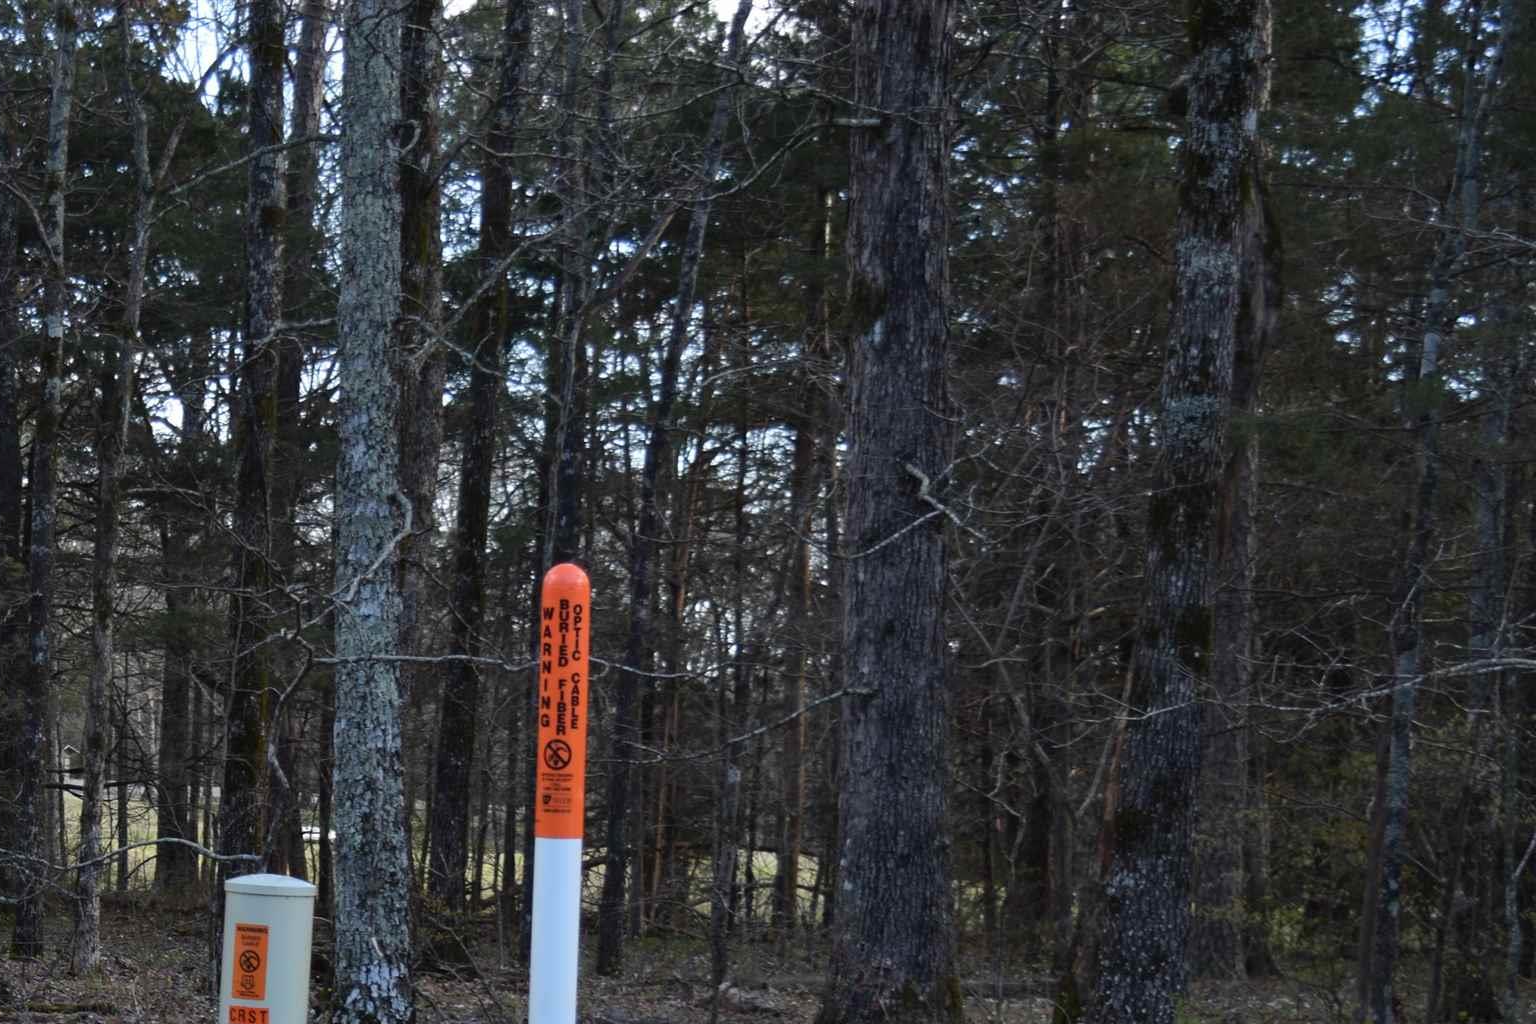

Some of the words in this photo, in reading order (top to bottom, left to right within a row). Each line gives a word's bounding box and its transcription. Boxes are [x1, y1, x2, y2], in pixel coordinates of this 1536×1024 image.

[559, 599, 570, 667] BURIED
[571, 604, 582, 661] OPTIC
[541, 606, 553, 728] WARNING
[556, 679, 567, 736] FIBER
[570, 672, 581, 730] CABLE
[229, 1008, 268, 1024] CRST
